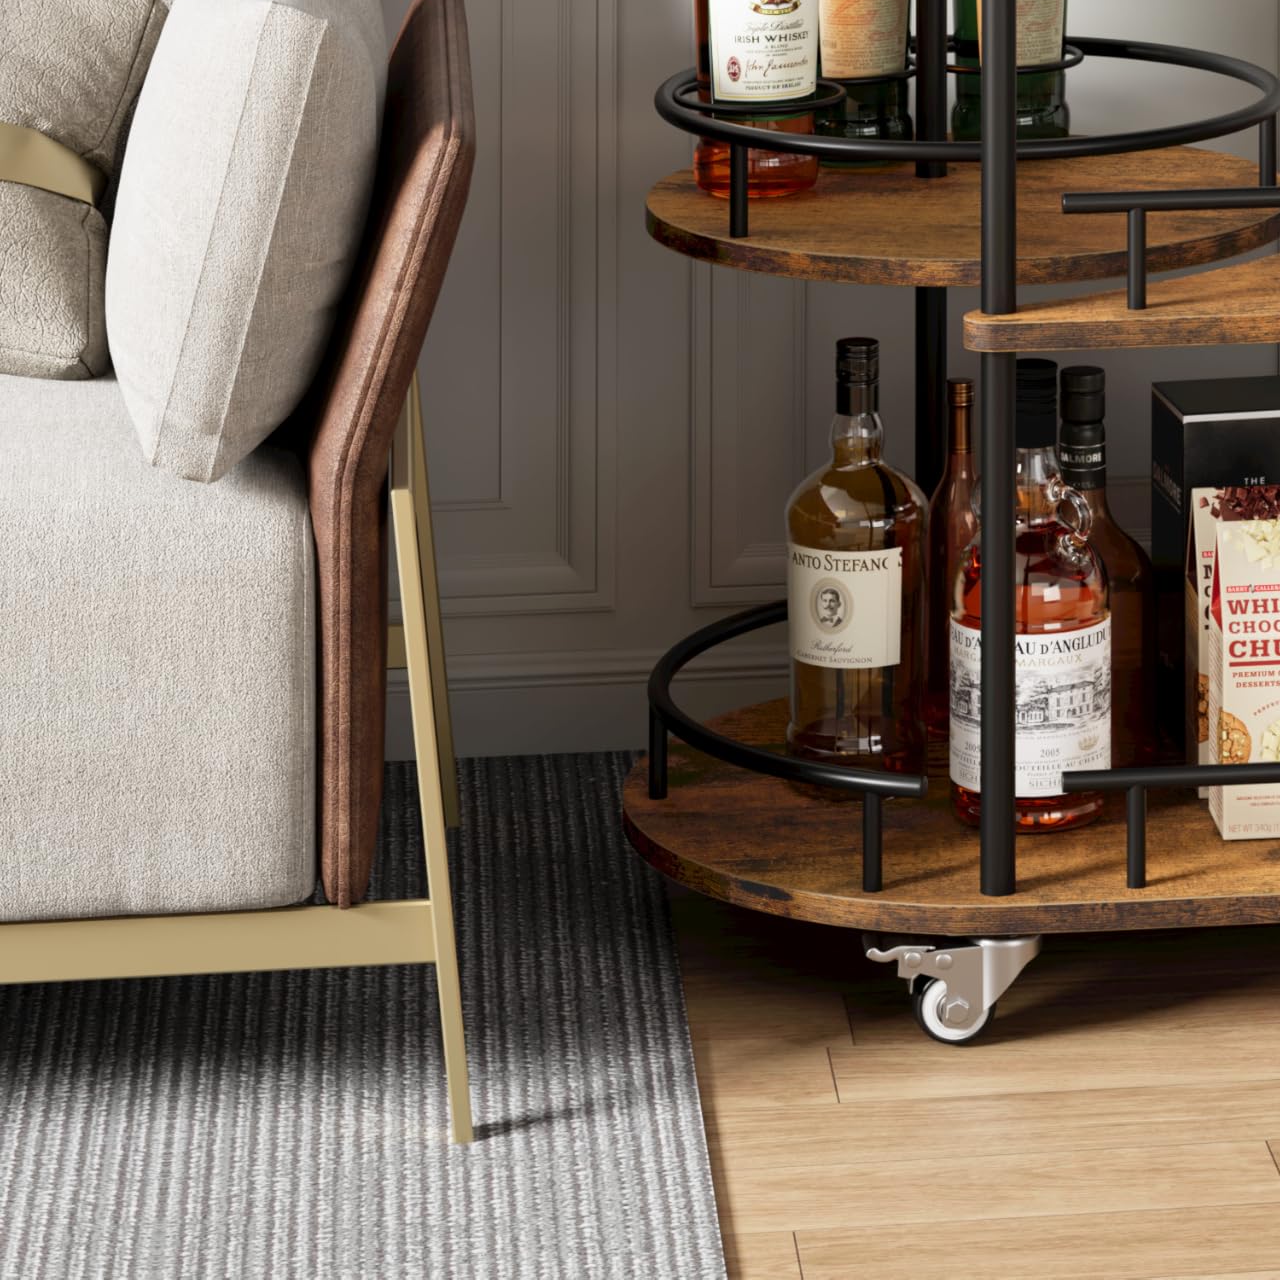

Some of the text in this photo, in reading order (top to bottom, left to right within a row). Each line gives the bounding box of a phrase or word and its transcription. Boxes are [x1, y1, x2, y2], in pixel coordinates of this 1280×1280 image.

[734, 31, 809, 43] IRISH WHISKEY
[1243, 477, 1266, 486] THE
[791, 551, 821, 570] ANTO
[1016, 654, 1083, 667] MARGAUX
[1232, 670, 1275, 678] PREMIUM
[1236, 680, 1280, 688] DESSERTS
